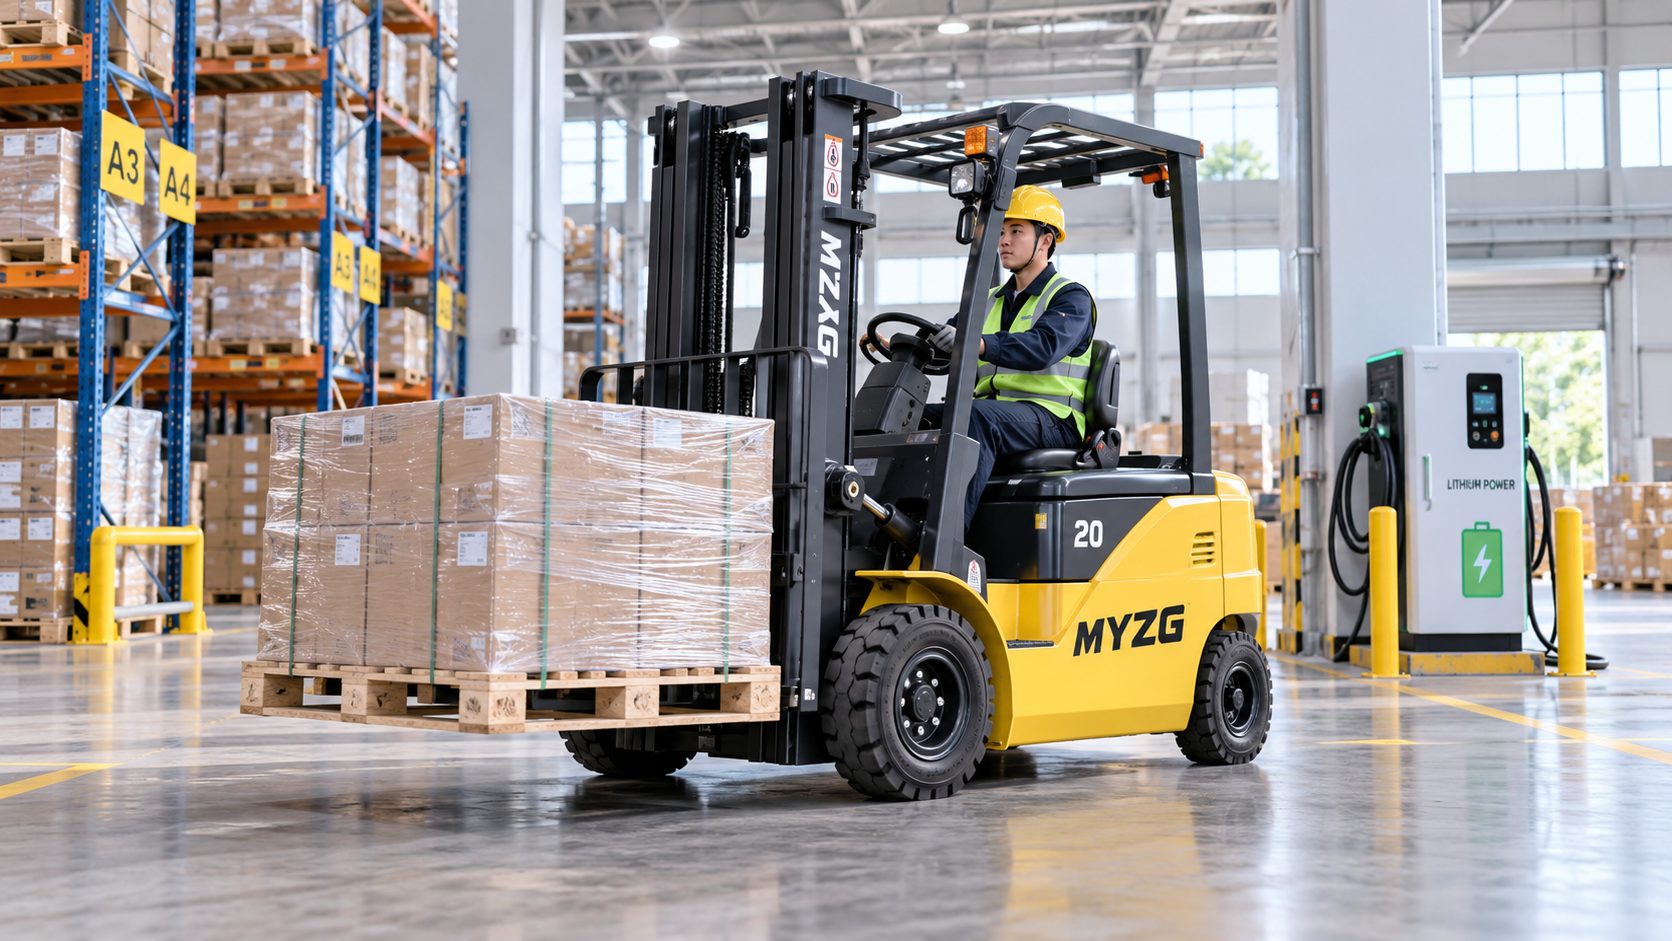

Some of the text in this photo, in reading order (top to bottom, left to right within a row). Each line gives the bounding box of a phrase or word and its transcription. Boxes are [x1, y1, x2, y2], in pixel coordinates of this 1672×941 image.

[107, 140, 139, 185] A3
[164, 166, 191, 207] A4
[335, 251, 351, 280] A3
[1483, 479, 1516, 490] POWER
[1073, 519, 1104, 548] 20
[1072, 604, 1185, 657] MYZG
